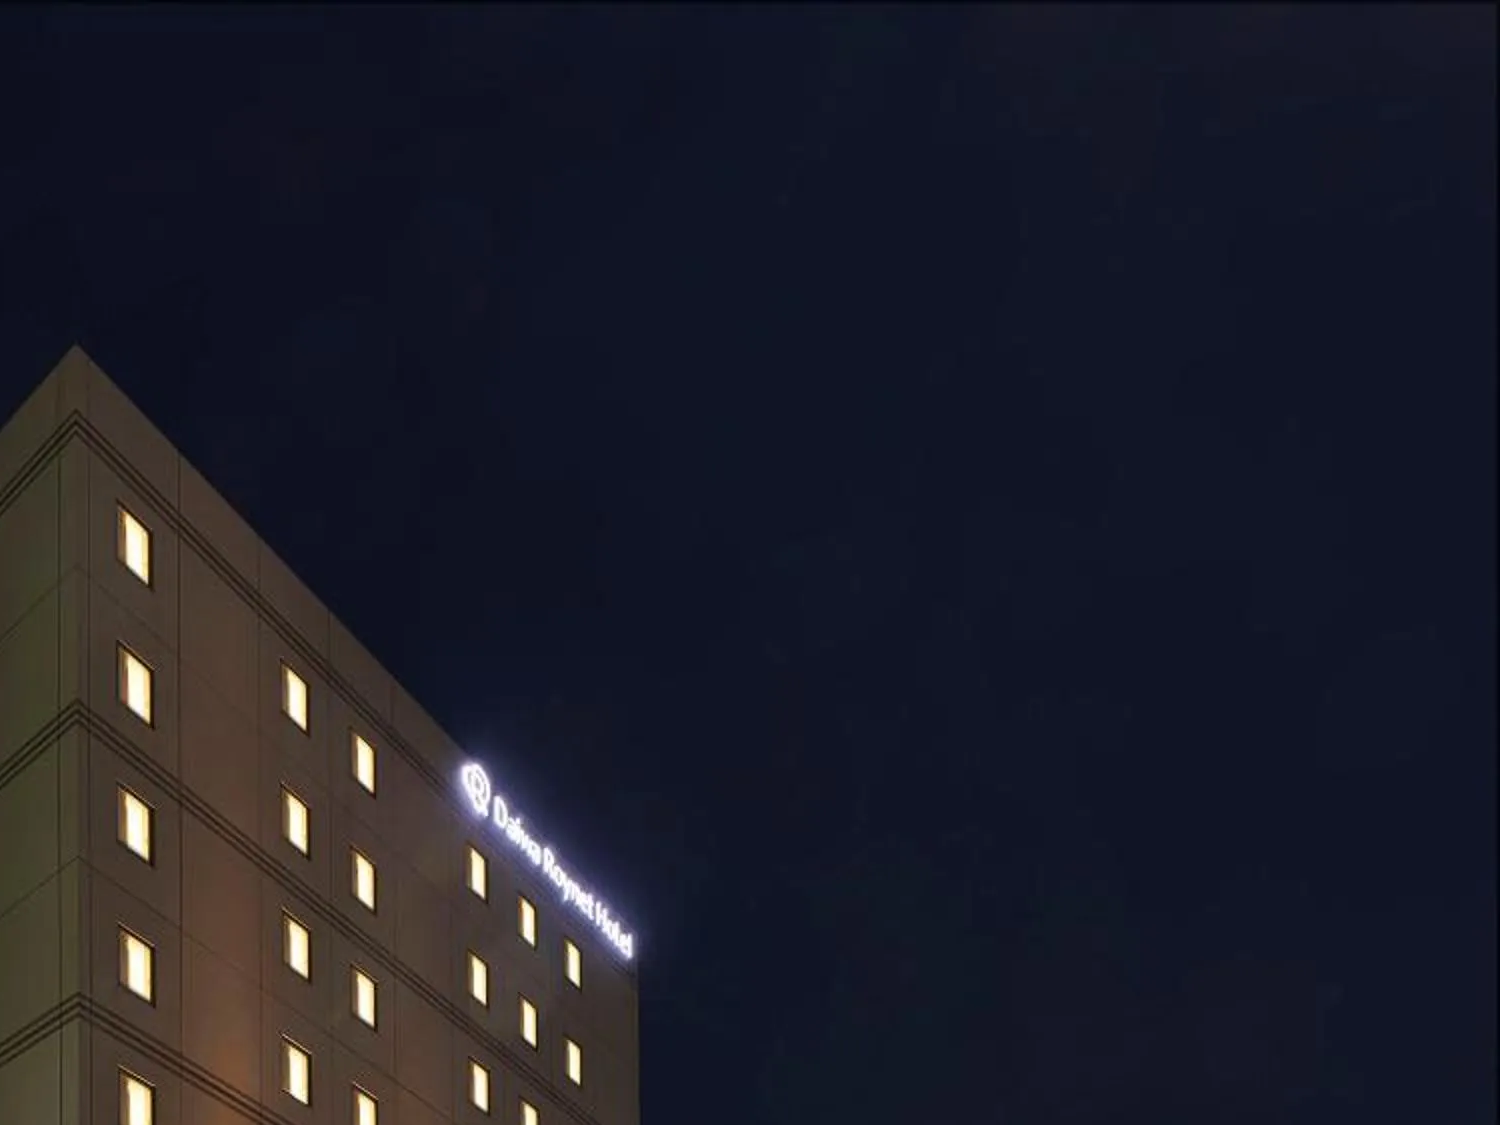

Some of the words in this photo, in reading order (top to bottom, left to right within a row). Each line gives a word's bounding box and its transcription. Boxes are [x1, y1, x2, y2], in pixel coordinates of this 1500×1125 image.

[493, 795, 541, 865] Daiwa
[542, 847, 595, 921] Roynet
[595, 900, 633, 959] Hotel
